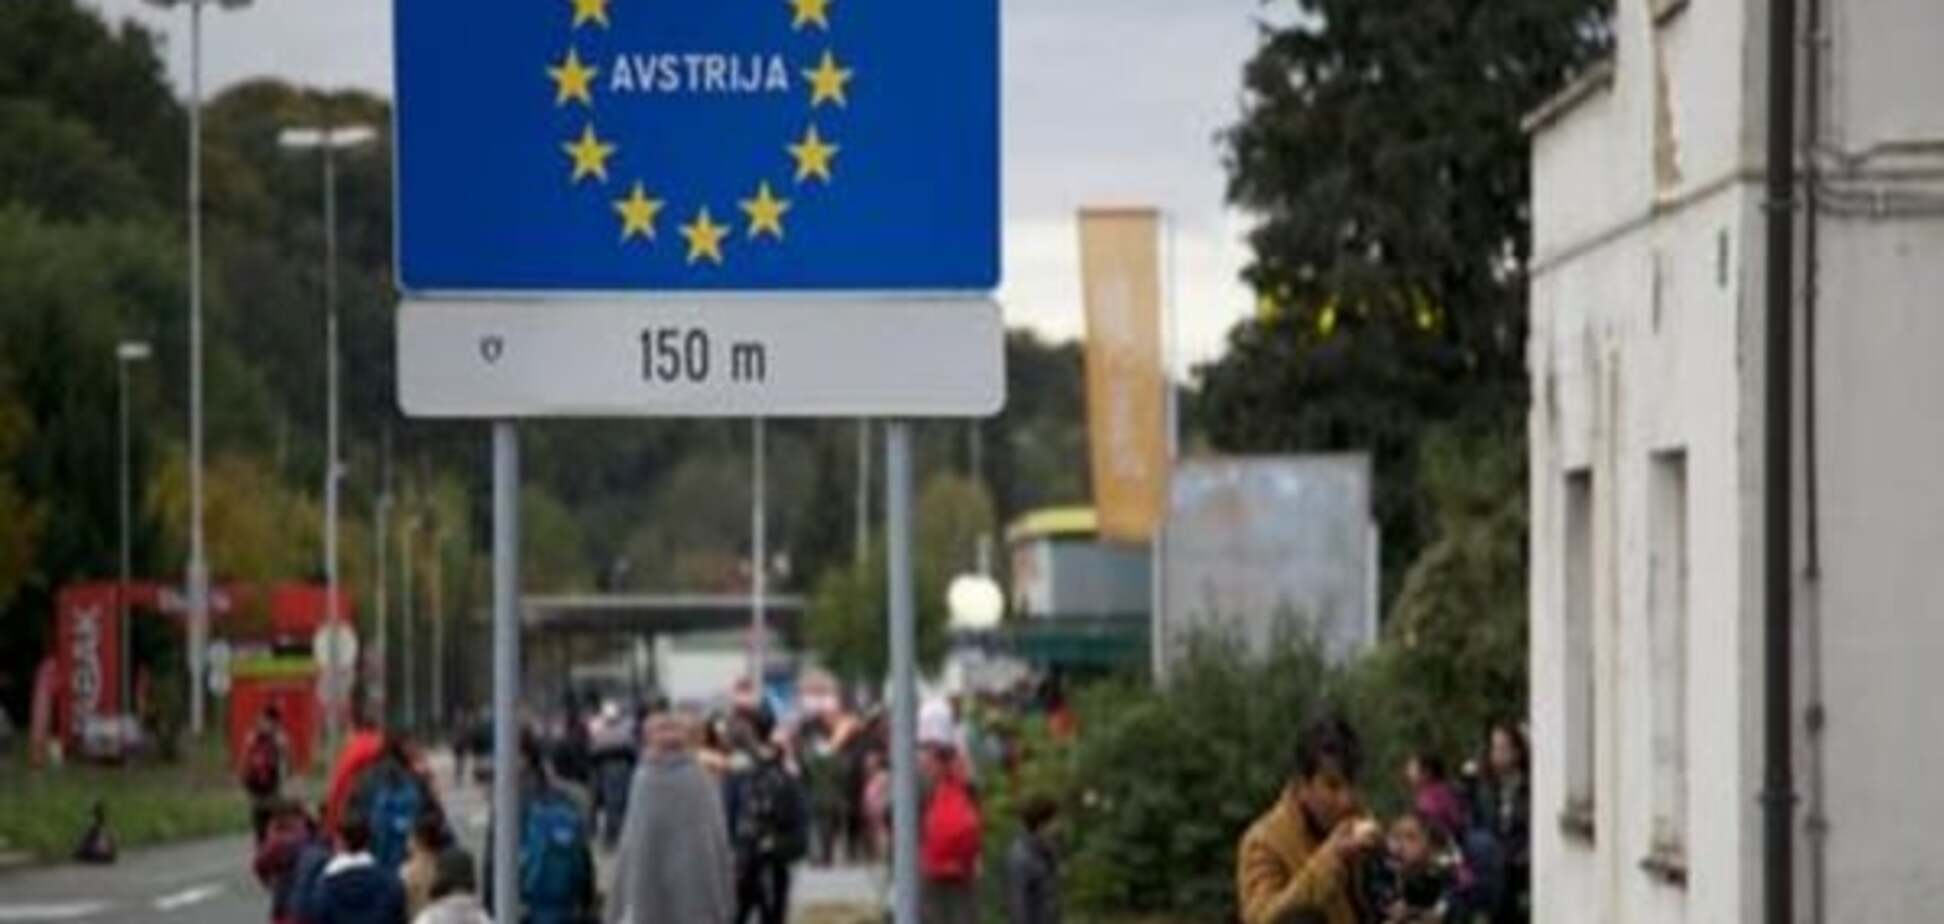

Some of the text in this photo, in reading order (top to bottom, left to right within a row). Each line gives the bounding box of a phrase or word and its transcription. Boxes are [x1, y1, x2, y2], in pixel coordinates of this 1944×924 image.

[610, 54, 789, 93] AVSTRIJA
[640, 328, 766, 383] 150 m
